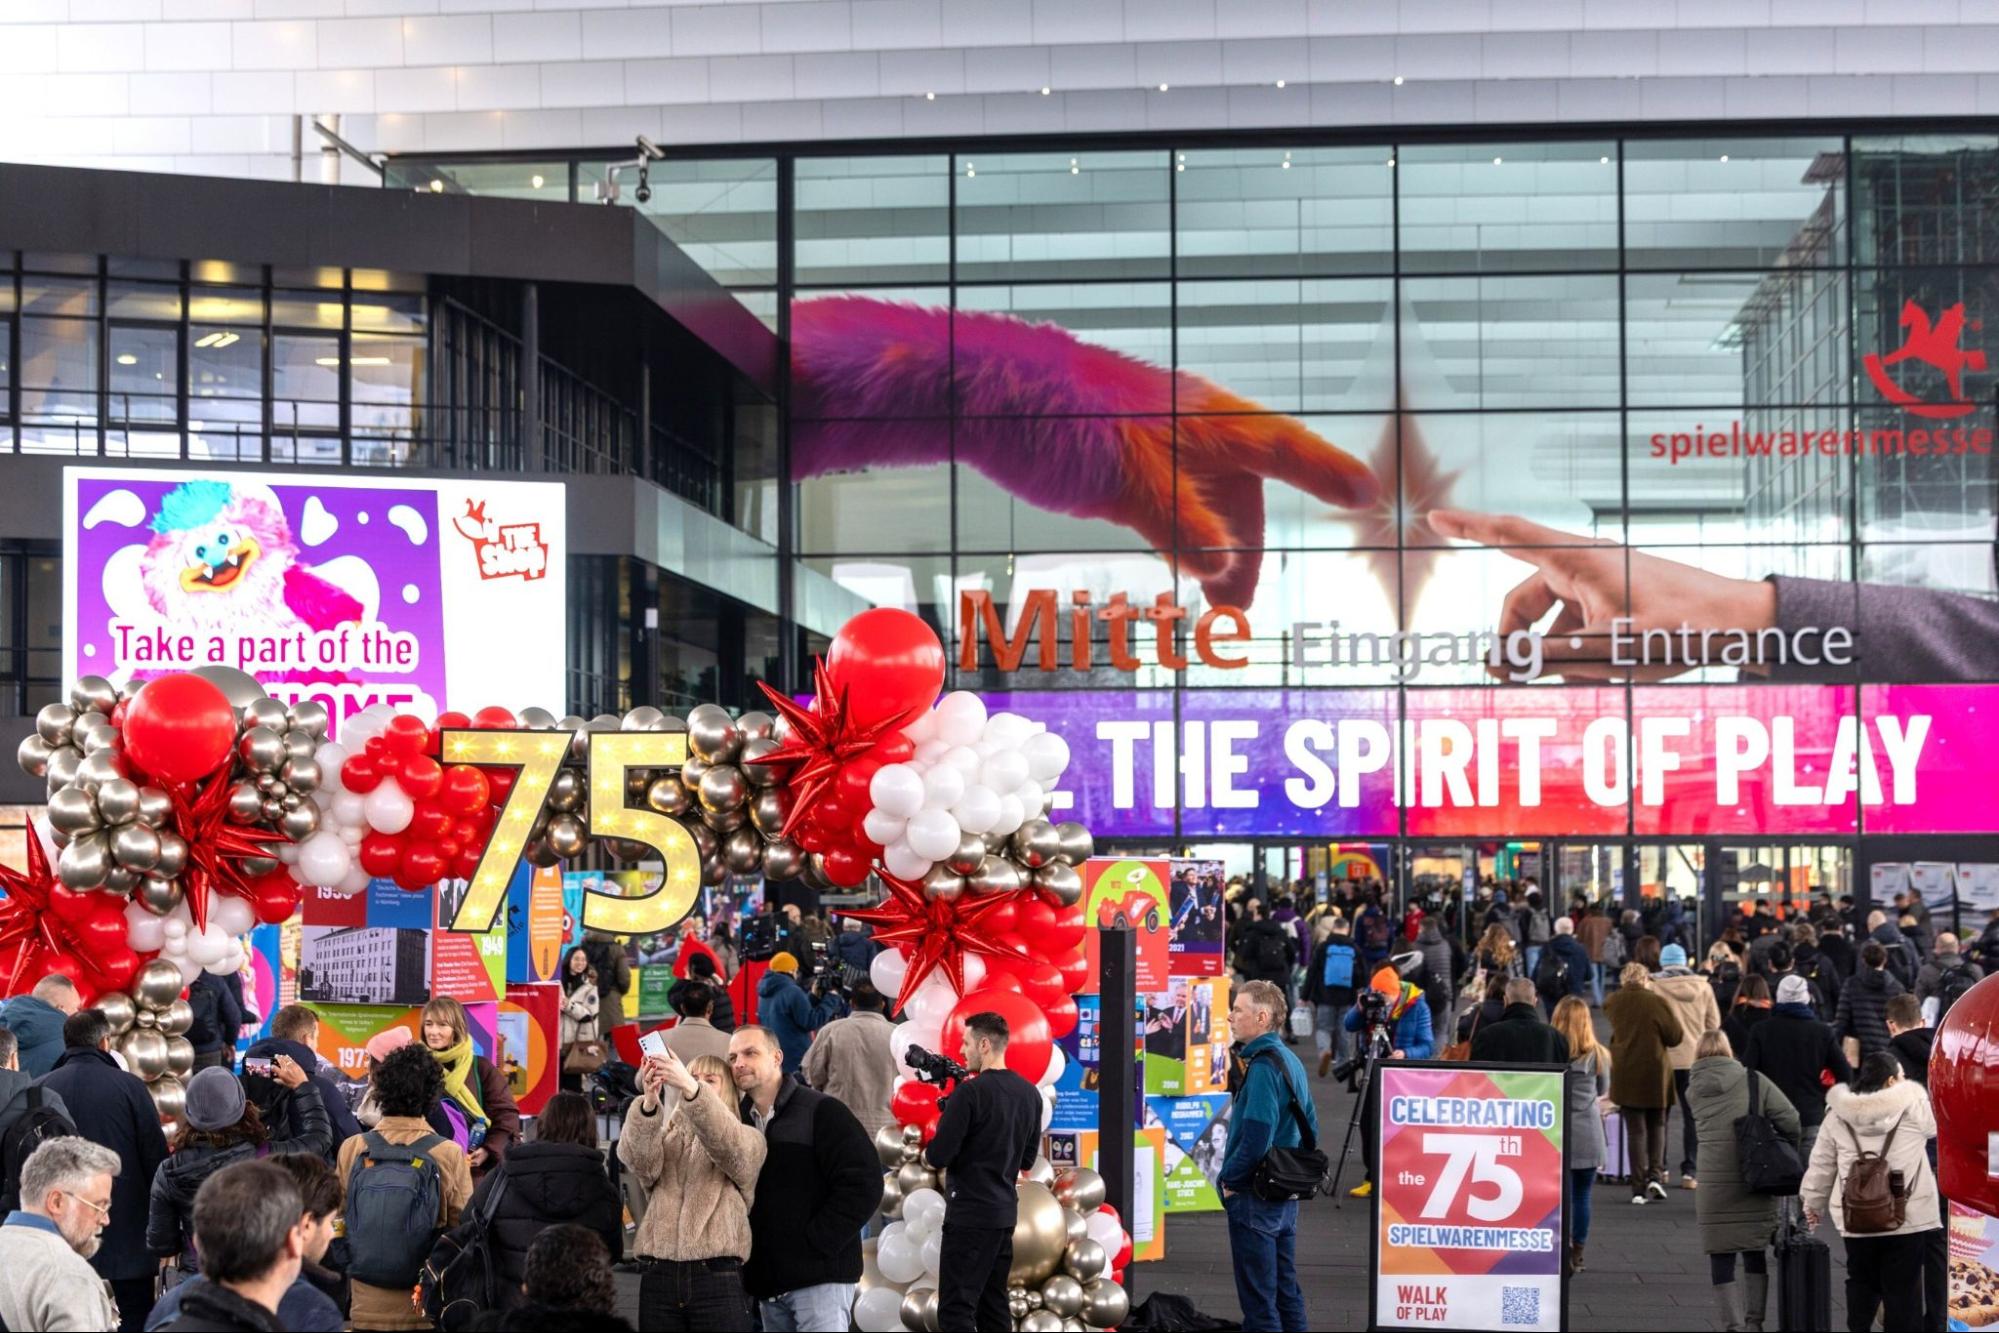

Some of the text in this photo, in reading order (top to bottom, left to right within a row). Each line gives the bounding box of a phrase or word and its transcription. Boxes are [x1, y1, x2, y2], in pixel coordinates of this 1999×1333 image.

[1650, 421, 1993, 465] spielwarenmesse
[115, 625, 412, 669] Take a part of the
[960, 589, 1854, 683] Mitte Eingang Entrance
[1096, 720, 1259, 809] THE
[1283, 718, 1558, 809] SPIRIT
[1583, 716, 1691, 808] OF
[1715, 714, 1933, 806] PLAY
[440, 728, 703, 935] 75
[1391, 1097, 1554, 1127] CELEBRATING
[1398, 1171, 1425, 1186] the
[1390, 1225, 1552, 1250] SPIELWARENMESSE
[1396, 1306, 1448, 1321] OF PLAY
[1397, 1285, 1448, 1305] WALK
